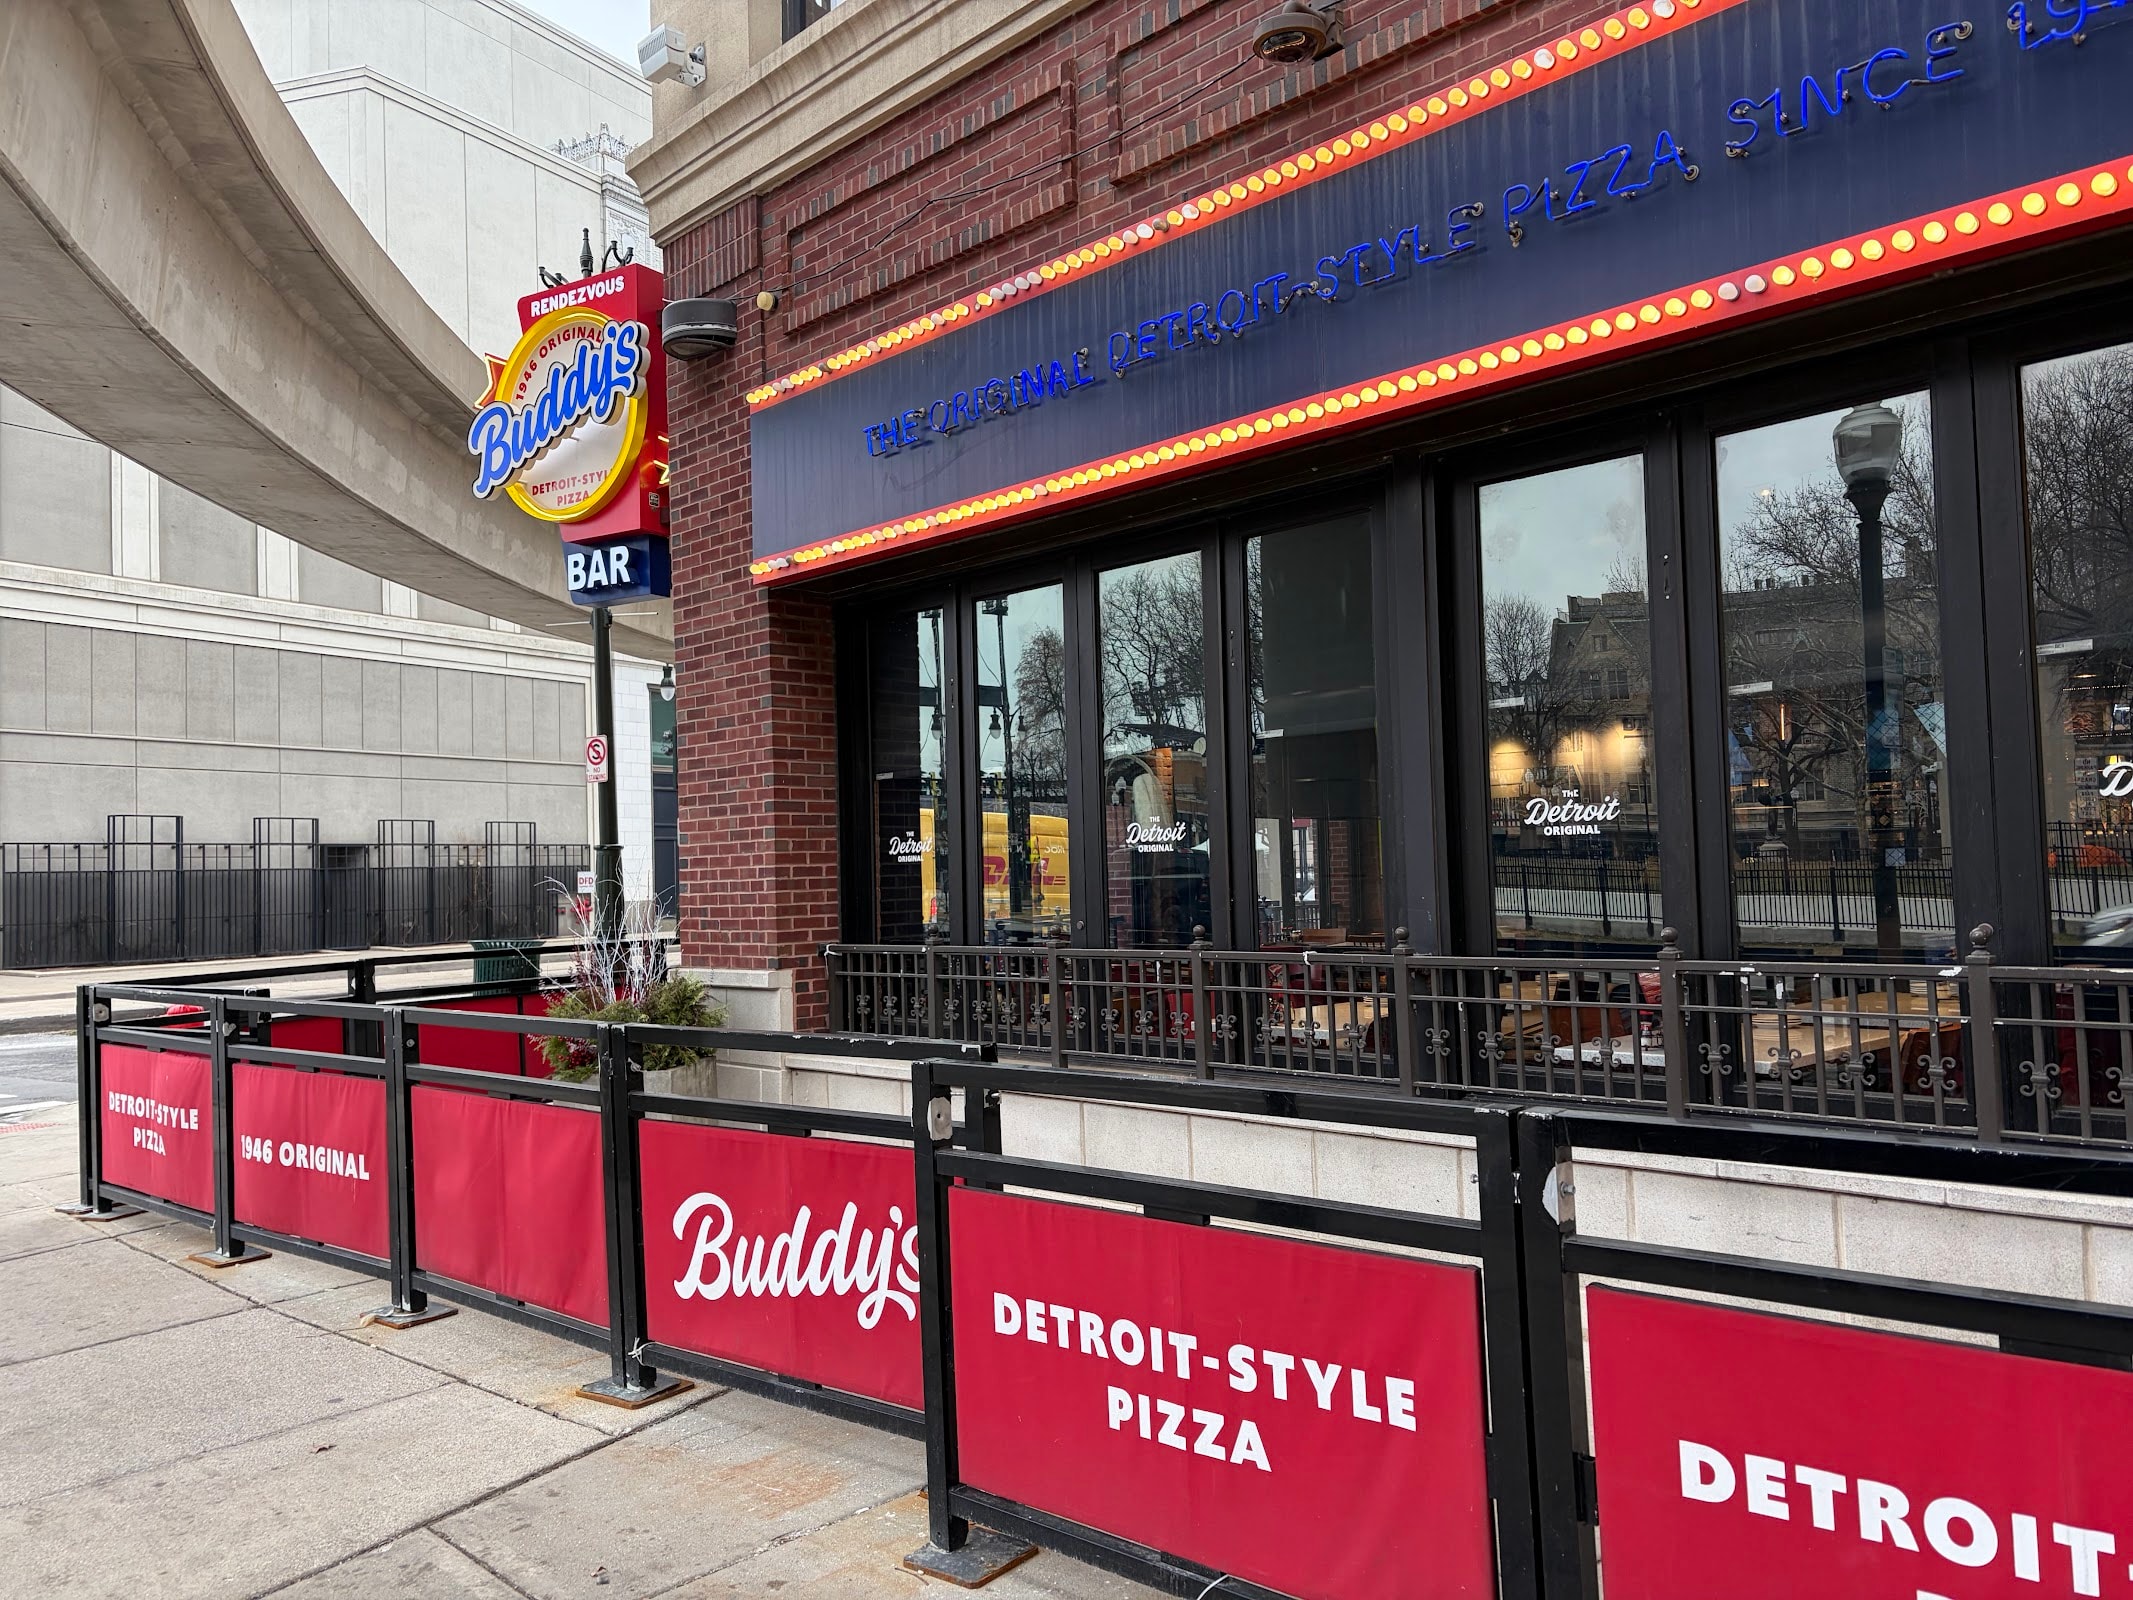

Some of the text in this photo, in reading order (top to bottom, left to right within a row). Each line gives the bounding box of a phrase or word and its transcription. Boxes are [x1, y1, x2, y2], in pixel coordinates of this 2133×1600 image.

[863, 409, 917, 456] THE
[929, 353, 1094, 432] ORIGINAL
[1503, 129, 1690, 231] PIZZA
[1727, 24, 1965, 148] SINCE
[531, 276, 625, 317] RENDEZVOUS
[515, 326, 602, 400] 1946 ORIGINAL
[470, 324, 637, 493] Buddy's
[532, 469, 609, 496] DETROIT-STYL
[557, 490, 590, 506] PIZZA
[567, 545, 631, 591] BAR
[1562, 789, 1579, 798] THE
[1524, 795, 1621, 825] Detroit
[1125, 821, 1187, 844] Detroit
[1543, 824, 1601, 836] ORIGINAL
[888, 836, 933, 855] Detroit
[897, 854, 924, 863] ORIGINAL
[1137, 843, 1175, 853] ORIGINAL
[578, 877, 594, 885] DFD
[108, 1091, 199, 1131] DETROIT-STYLE
[133, 1126, 167, 1156] PIZZA
[240, 1134, 370, 1181] 1946 ORIGINAL
[672, 1192, 921, 1330] Buddy's
[993, 1292, 1417, 1433] DETROIT-STYLE
[1107, 1386, 1273, 1473] PIZZA
